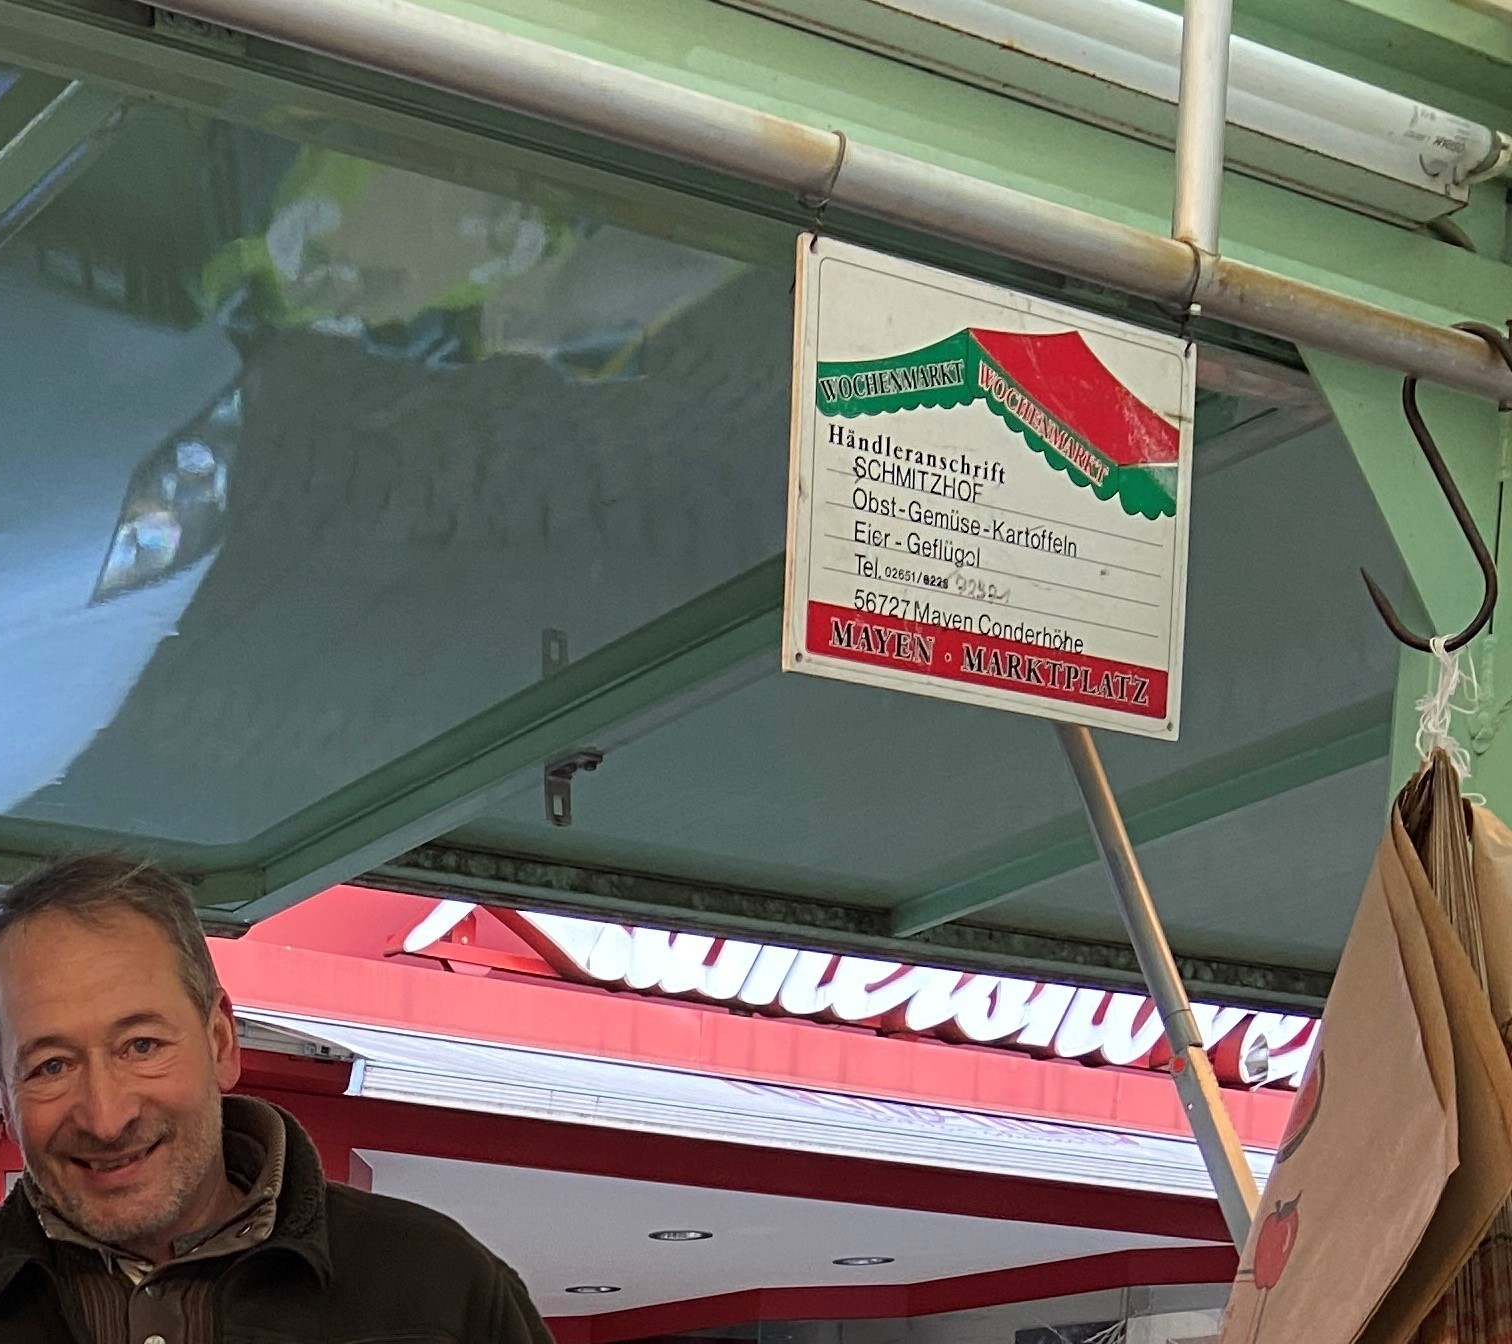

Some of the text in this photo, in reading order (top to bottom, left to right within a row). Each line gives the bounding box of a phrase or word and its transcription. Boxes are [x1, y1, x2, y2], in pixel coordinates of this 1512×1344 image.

[820, 359, 965, 402] WOCHENMARKT
[978, 362, 1110, 487] WOCHENMARKT
[828, 424, 1007, 485] Händleranschrift
[853, 456, 985, 504] SCHMITZHOF
[854, 520, 890, 548] Eier
[855, 553, 882, 580] Tel.
[854, 589, 1085, 654] 56727 Mayen Conderhöhe
[830, 616, 1150, 706] MAYEN MARKTPLATZ
